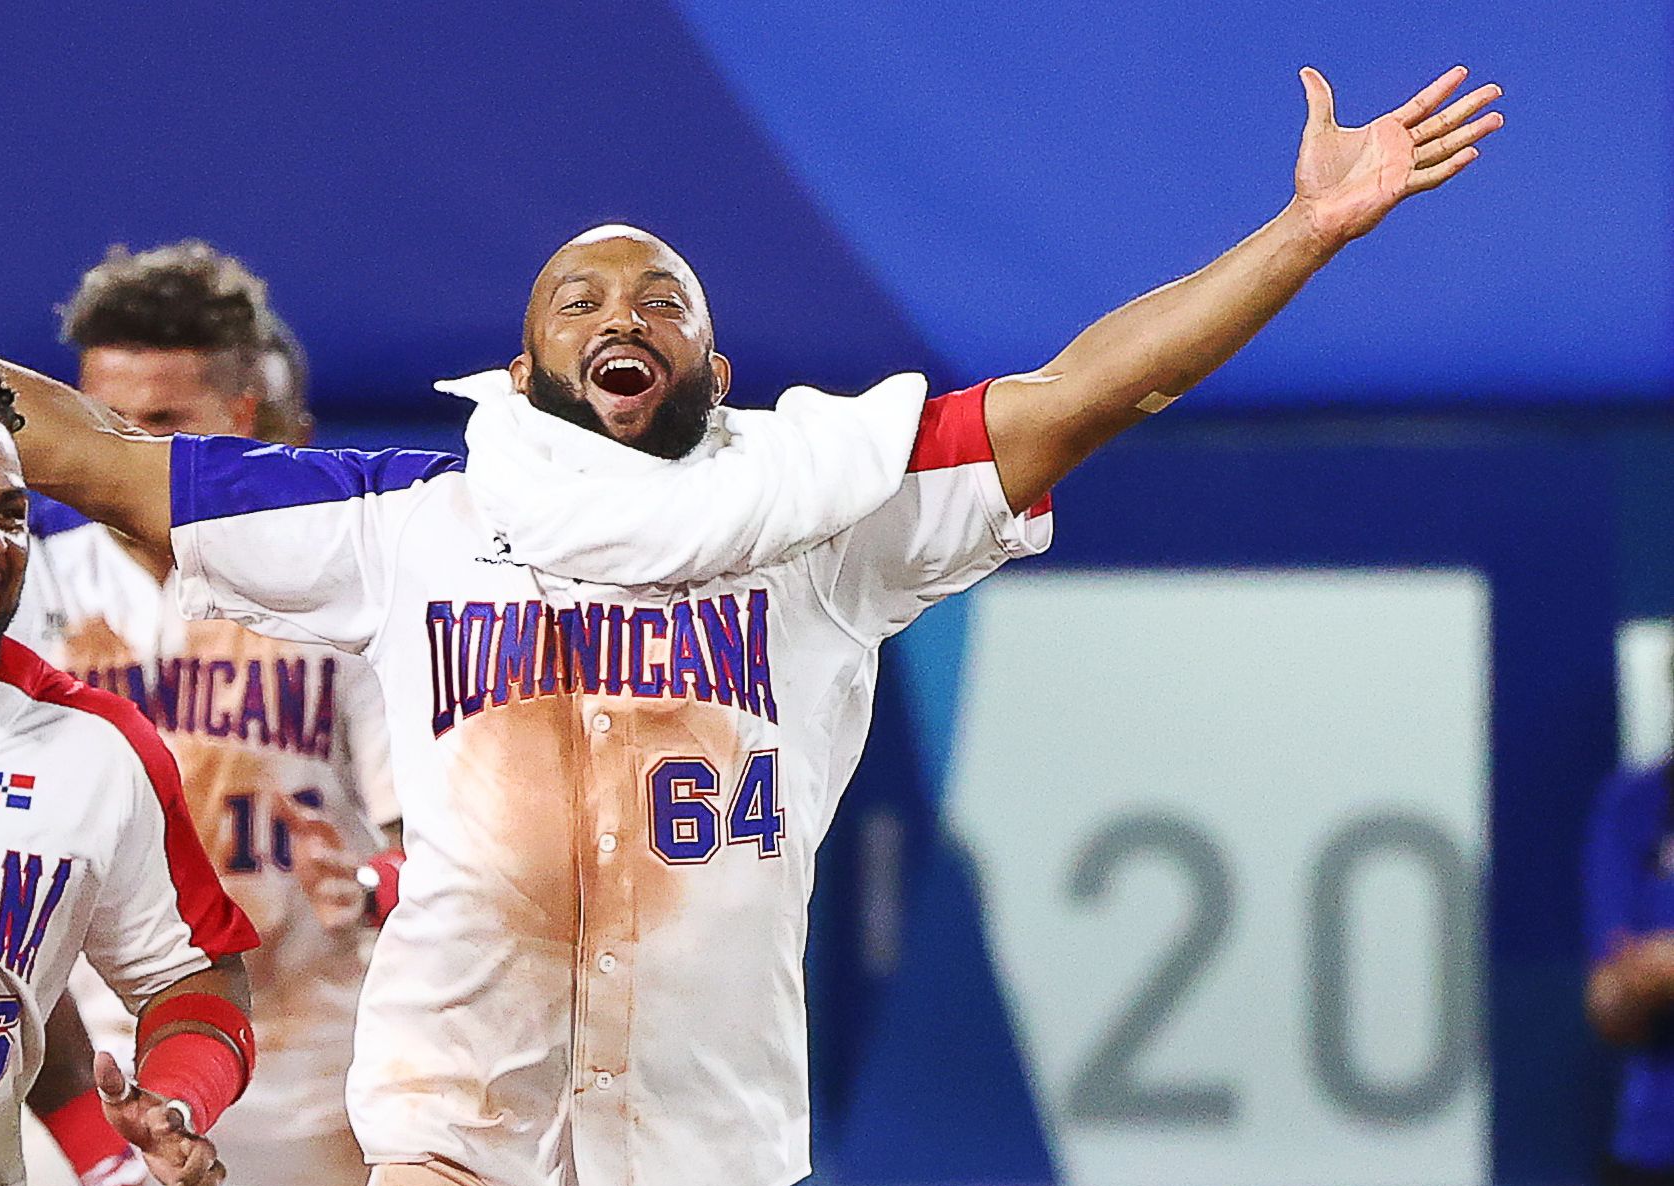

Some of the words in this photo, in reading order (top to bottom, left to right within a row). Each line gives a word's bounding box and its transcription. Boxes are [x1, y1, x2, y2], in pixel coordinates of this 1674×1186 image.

[66, 656, 335, 756] NICANA
[426, 588, 779, 741] DOMINICANA
[645, 748, 786, 865] 64
[1059, 808, 1488, 1128] 20
